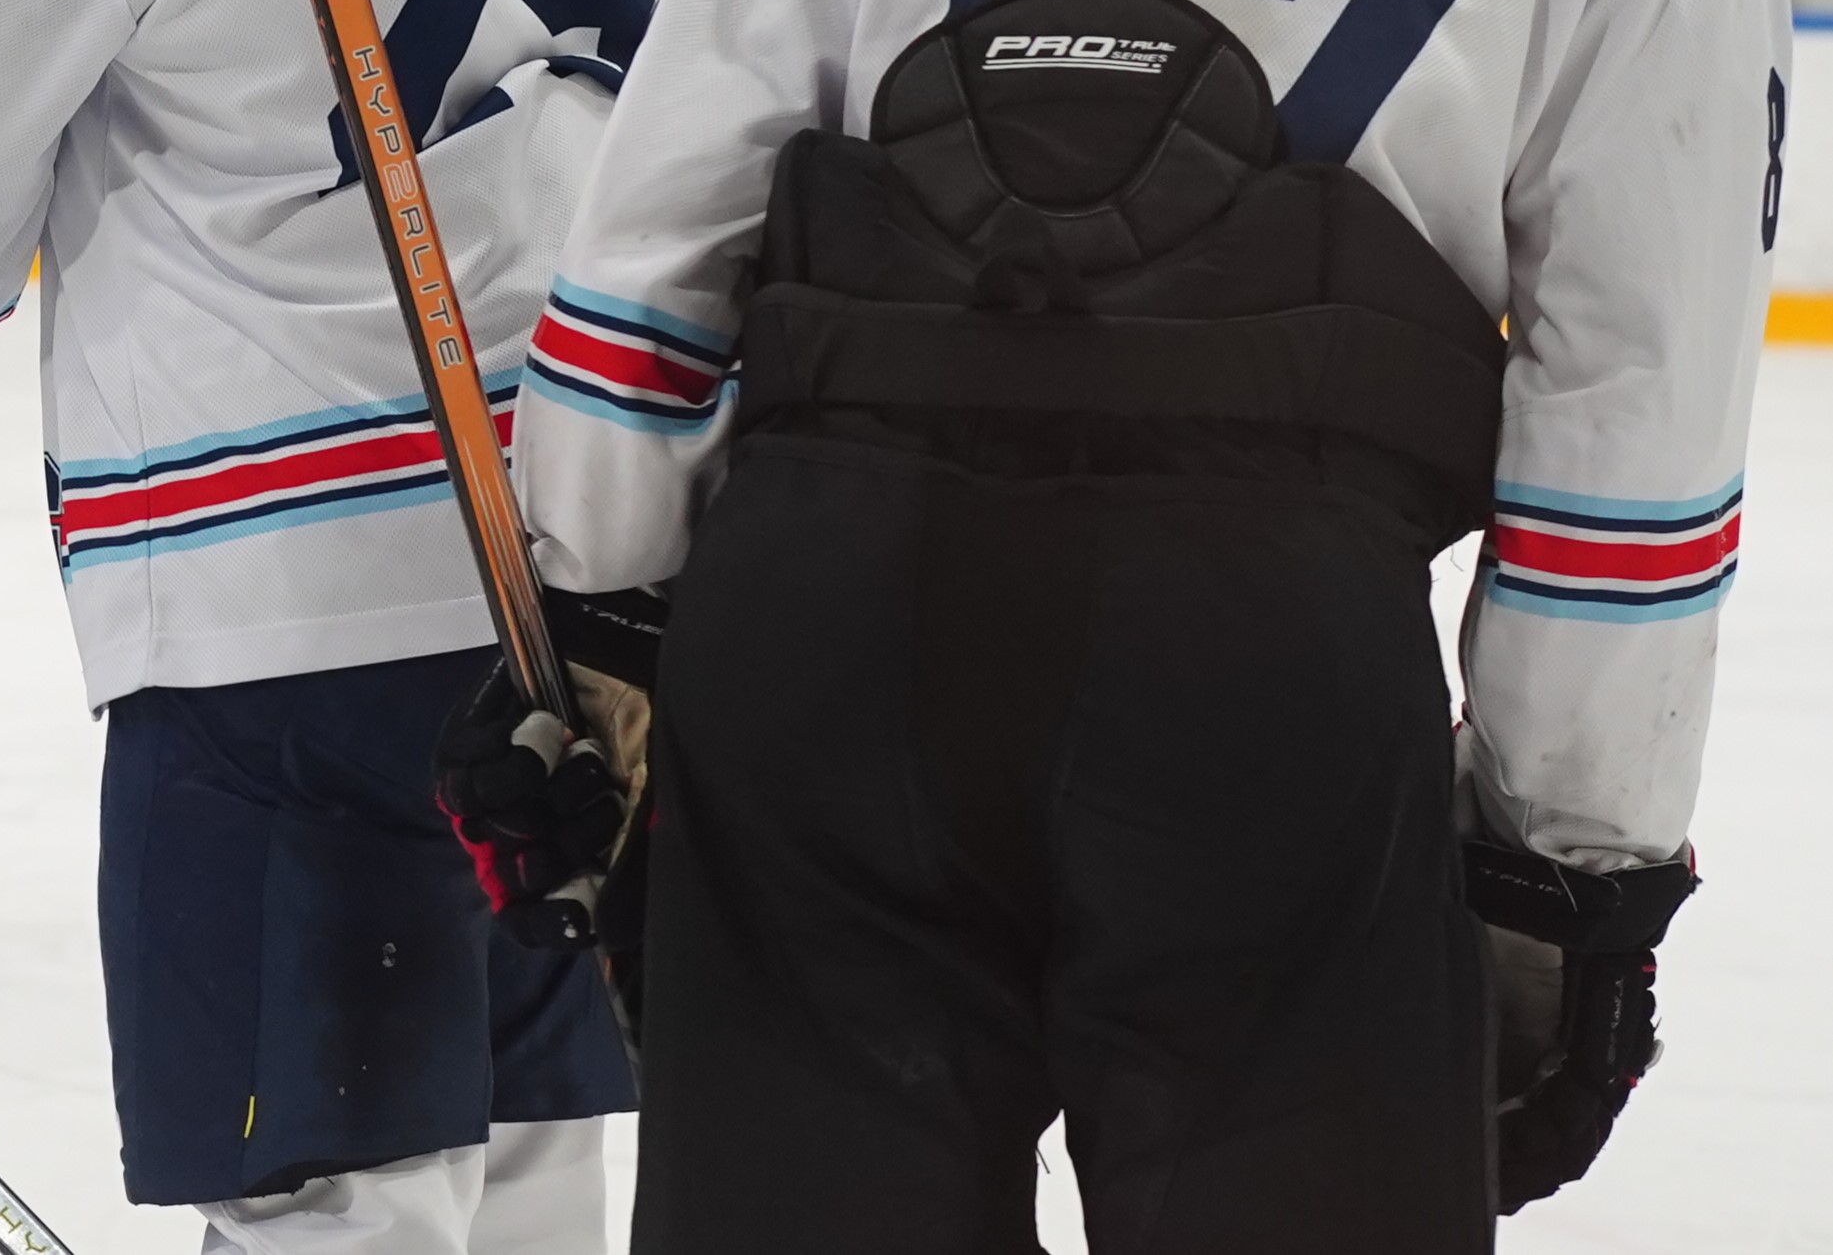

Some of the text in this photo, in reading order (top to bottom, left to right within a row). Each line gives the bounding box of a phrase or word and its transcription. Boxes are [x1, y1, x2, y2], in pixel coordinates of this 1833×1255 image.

[985, 36, 1177, 58] PRO TRUE
[1110, 51, 1168, 62] SERIES
